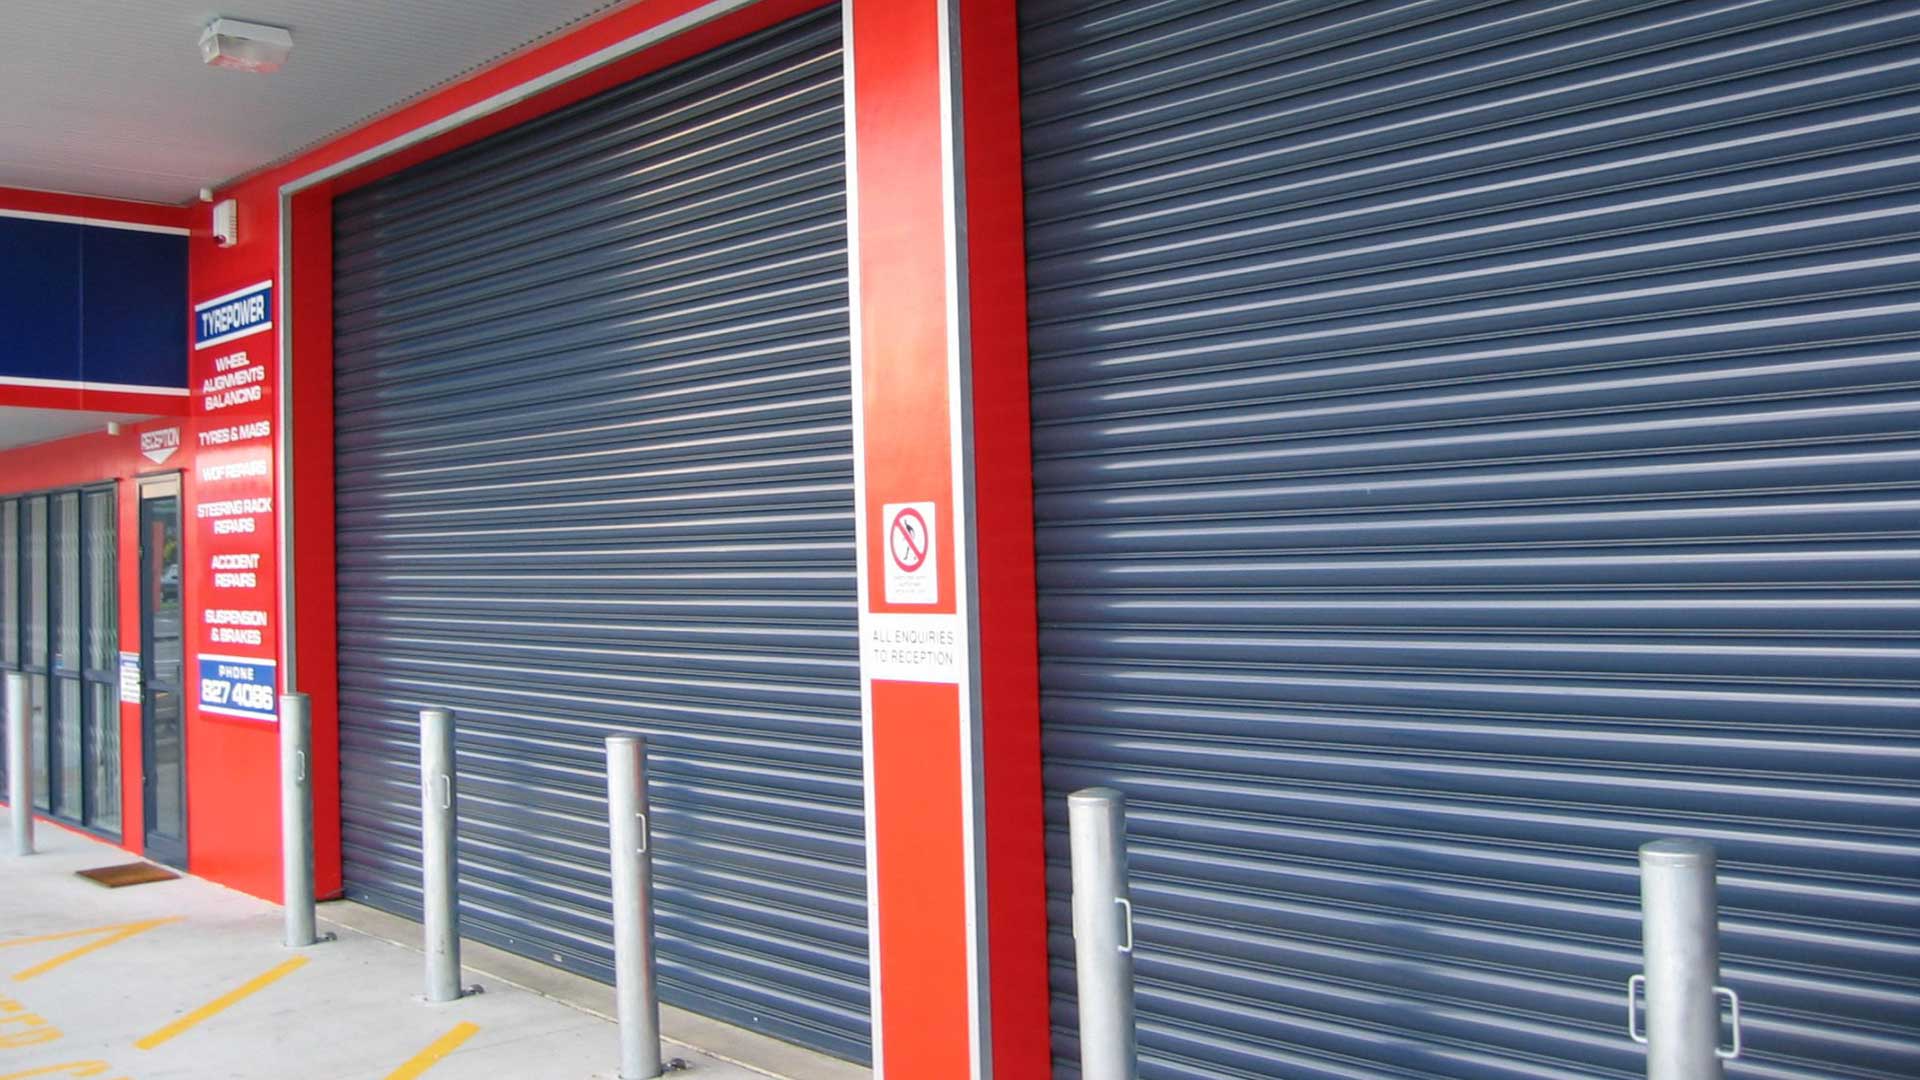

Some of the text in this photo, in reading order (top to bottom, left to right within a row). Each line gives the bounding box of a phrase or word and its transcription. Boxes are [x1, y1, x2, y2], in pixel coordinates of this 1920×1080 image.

[202, 294, 265, 337] TYREPOWER
[215, 351, 250, 372] WHEEL
[203, 365, 265, 394] ALIGNMENTS
[205, 385, 262, 411] BALANCING
[198, 420, 271, 446] TYRES & MAGS
[202, 460, 267, 481] WOF REPAIRS
[197, 497, 273, 518] STEERING RACK
[214, 517, 255, 535] REPAIRS
[211, 553, 260, 570] ACCIDENT
[214, 572, 257, 588] REPAIRS
[204, 609, 268, 626] SUSPENSION
[210, 627, 262, 645] & BRAKES
[872, 629, 954, 645] ALL ENQUIRIES
[873, 648, 953, 666] TO RECEPTION
[218, 664, 254, 681] PHONE
[202, 678, 274, 710] 827 4086
